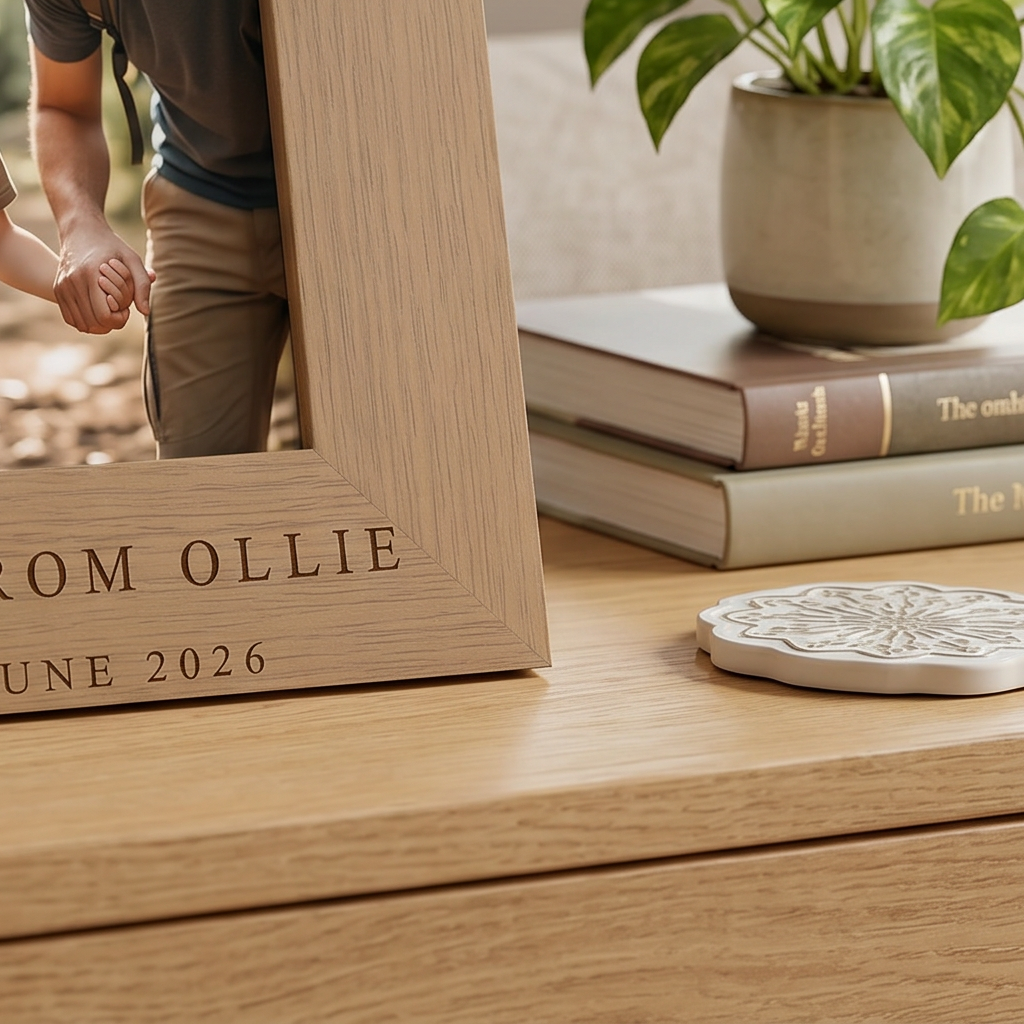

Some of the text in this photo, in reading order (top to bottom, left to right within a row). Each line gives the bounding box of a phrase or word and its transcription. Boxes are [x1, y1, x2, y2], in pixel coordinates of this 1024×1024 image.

[936, 395, 977, 422] The
[952, 485, 1005, 515] The
[180, 526, 401, 586] OLLIE
[145, 642, 267, 684] 2026
